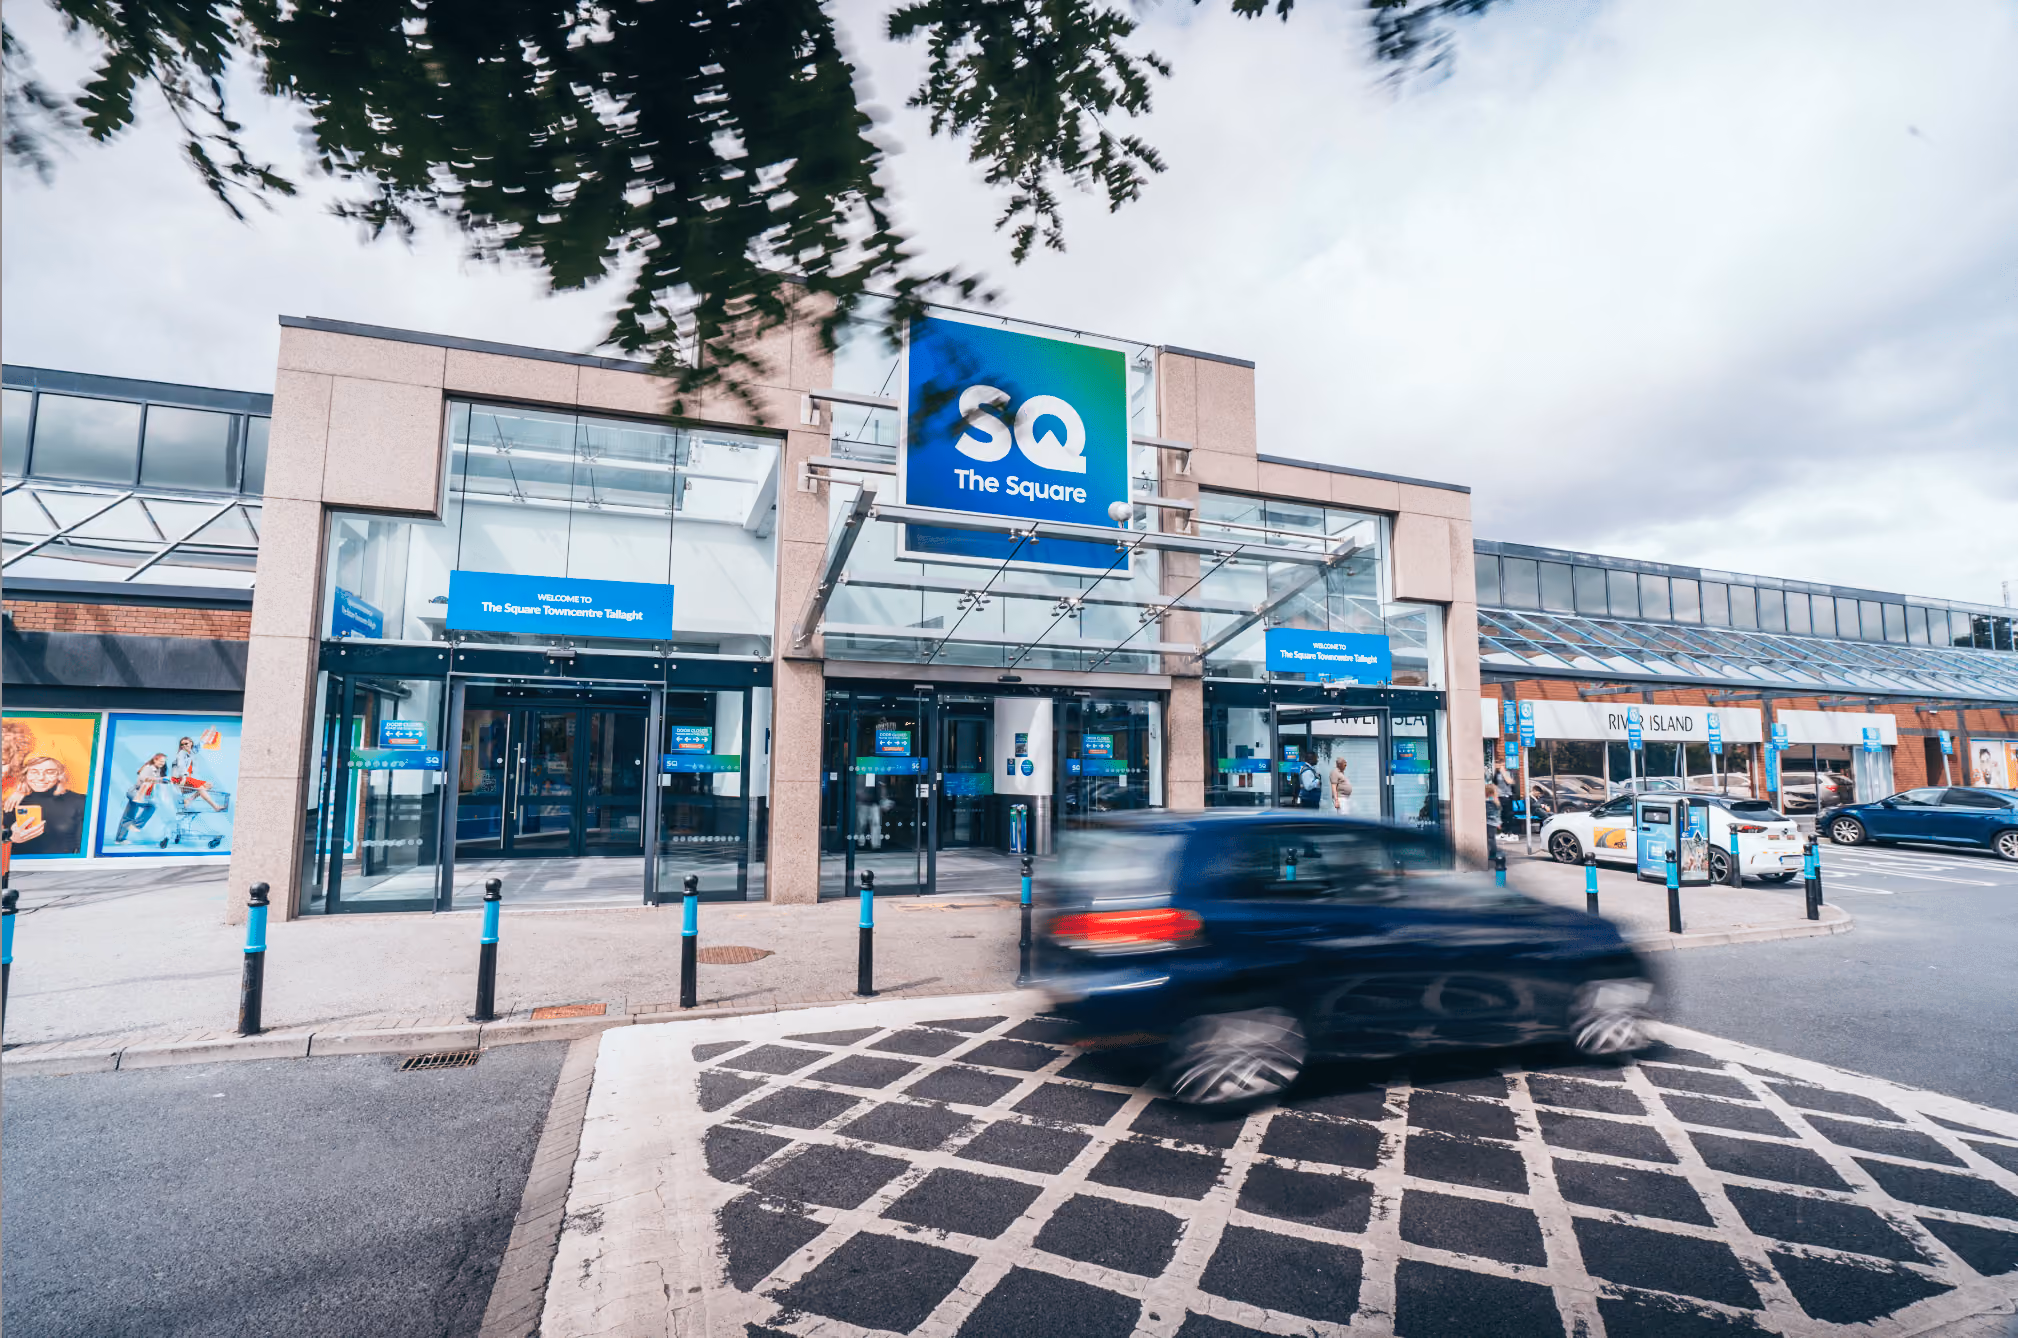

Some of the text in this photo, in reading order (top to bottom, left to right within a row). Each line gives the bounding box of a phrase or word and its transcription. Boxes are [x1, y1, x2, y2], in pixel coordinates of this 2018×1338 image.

[954, 384, 1087, 474] SQ
[954, 468, 1087, 504] The Square
[537, 593, 593, 604] WELCOME TO
[481, 601, 644, 622] The Square Towncentre Tallaght
[1279, 649, 1294, 659] The
[1293, 650, 1317, 661] Square
[1608, 713, 1645, 732] RIVR
[1649, 715, 1694, 733] ISLAND
